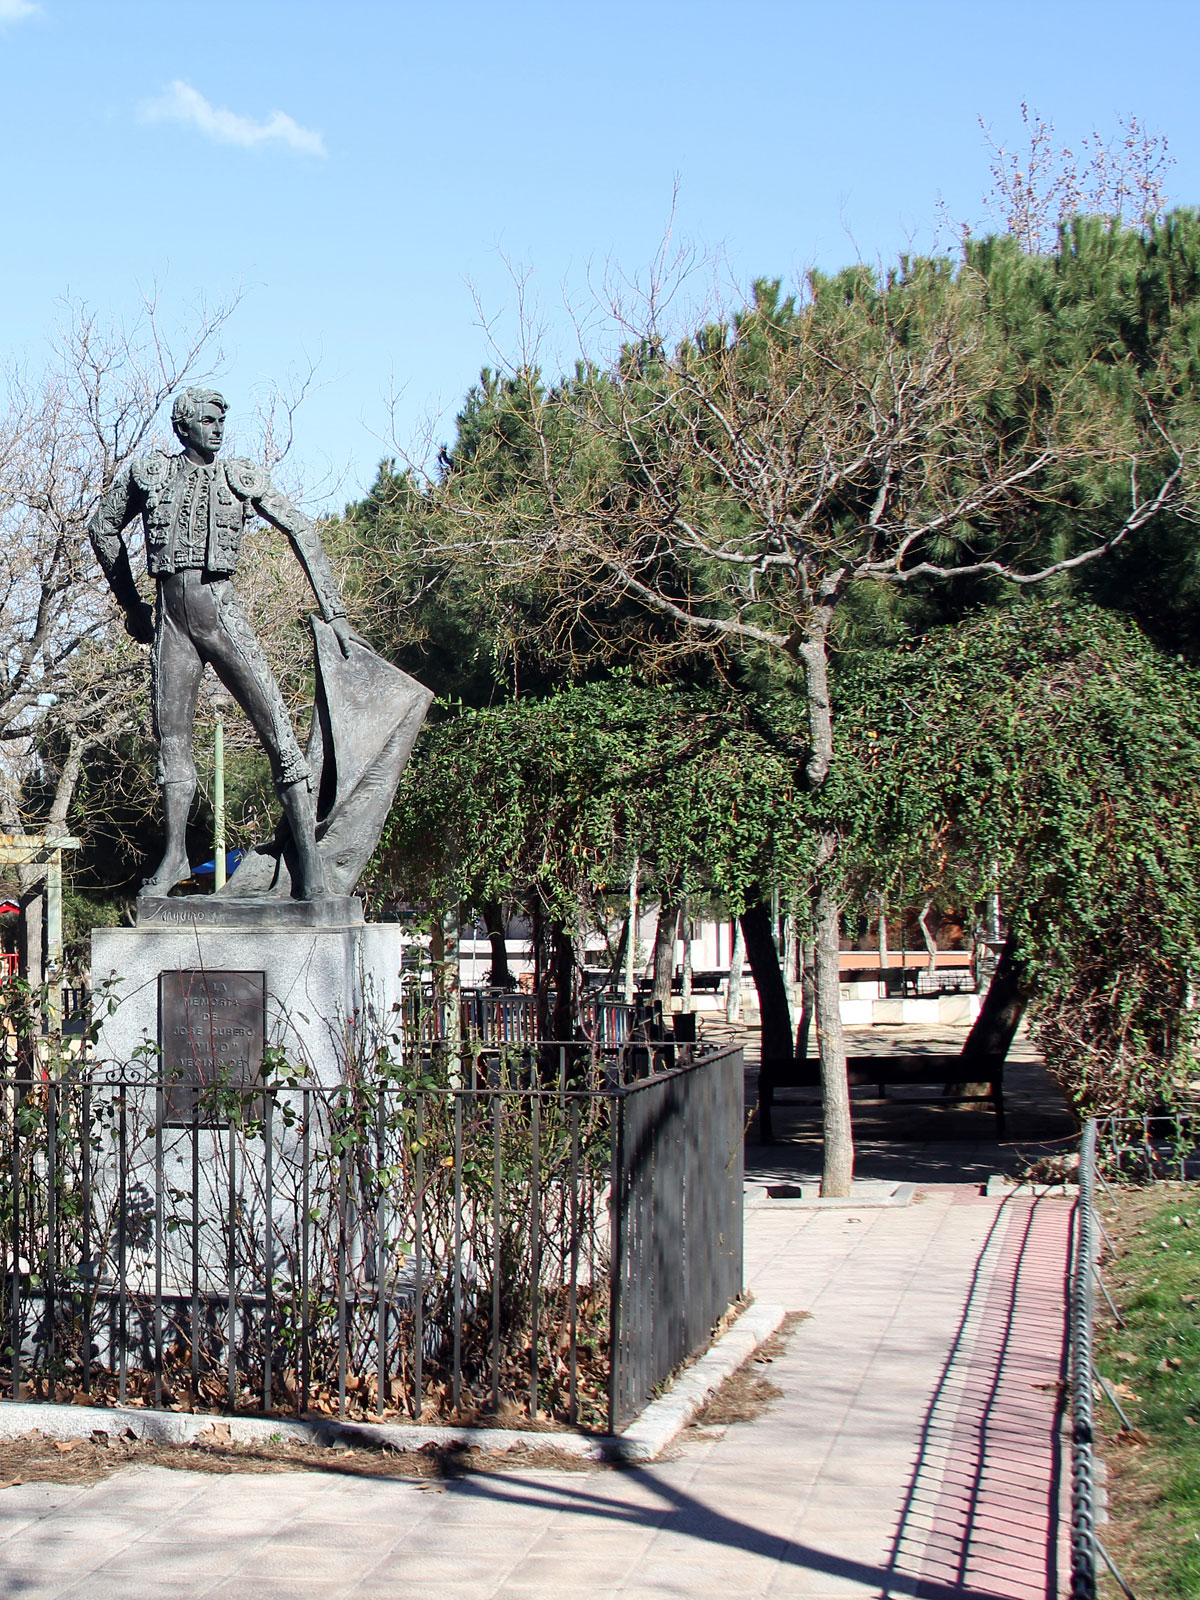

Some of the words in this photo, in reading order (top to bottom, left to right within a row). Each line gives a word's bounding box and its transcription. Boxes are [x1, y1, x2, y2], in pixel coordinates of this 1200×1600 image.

[198, 982, 207, 992] A
[211, 982, 228, 992] LA
[184, 996, 240, 1008] MEMORIA
[201, 1012, 219, 1022] DE
[209, 1026, 256, 1037] CUBERO
[230, 1057, 245, 1068] DE
